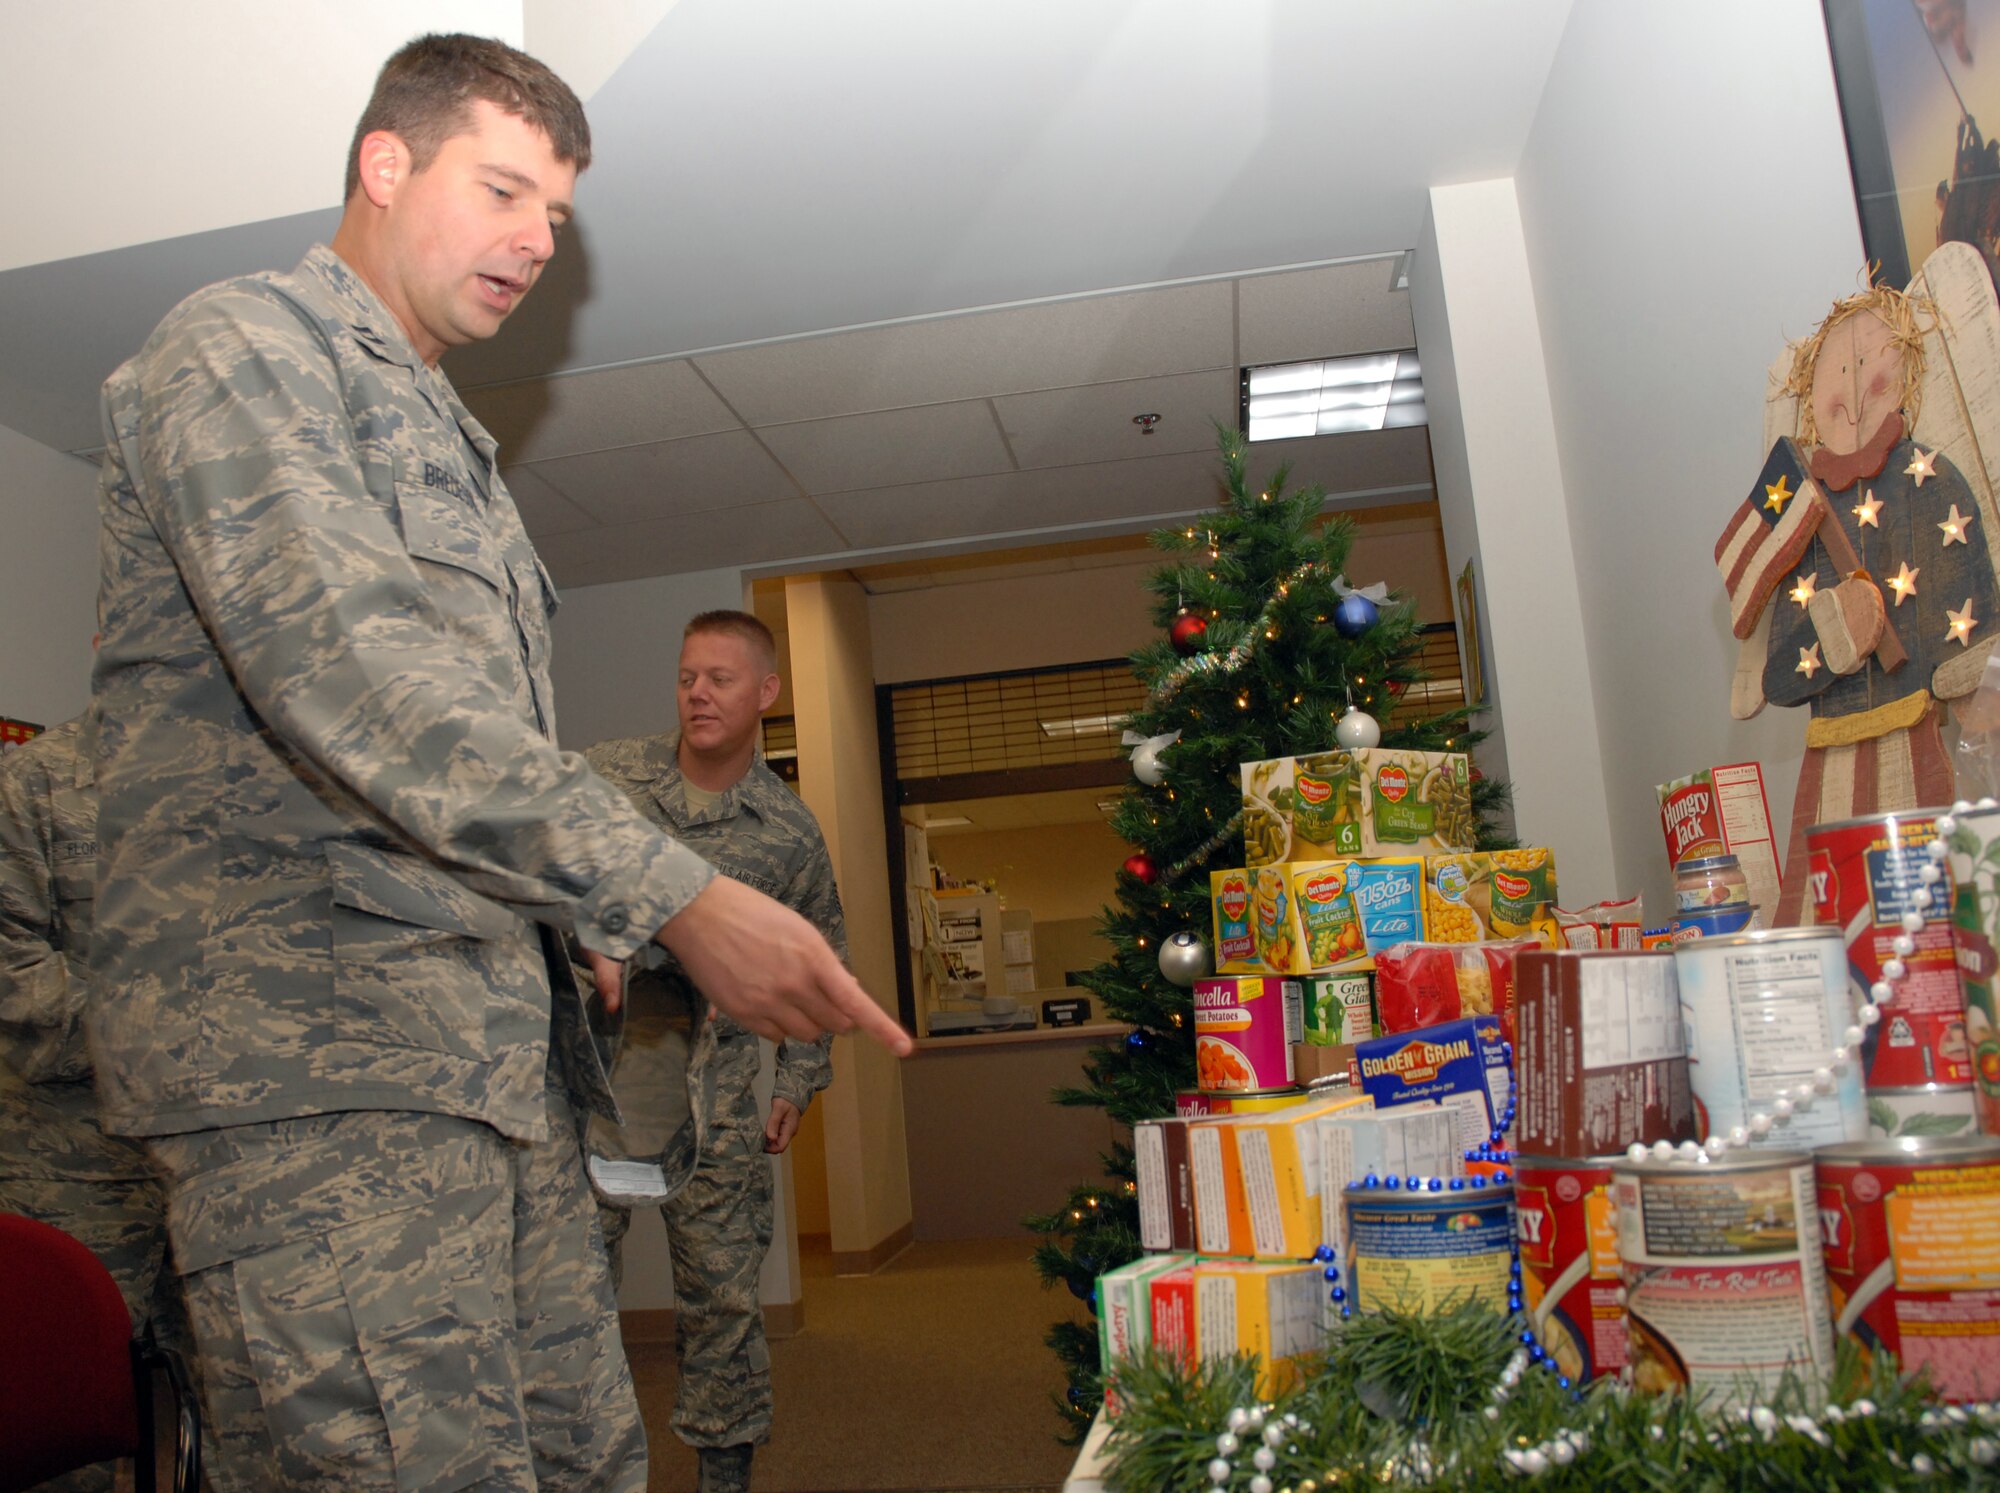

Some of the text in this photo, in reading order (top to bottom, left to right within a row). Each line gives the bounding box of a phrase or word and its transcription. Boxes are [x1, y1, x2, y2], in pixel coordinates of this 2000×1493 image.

[1457, 761, 1464, 776] 6
[1380, 776, 1406, 788] Del Monte
[1664, 792, 1709, 835] Hungry
[1341, 824, 1353, 844] 6
[1675, 817, 1705, 855] Jack
[1337, 845, 1359, 853] CANS
[719, 864, 777, 894] U.S. AIR FORCE
[1386, 870, 1394, 881] 6
[1307, 881, 1340, 896] Del Monte
[1497, 876, 1528, 891] Del Monte
[1375, 898, 1401, 911] cans
[1371, 919, 1409, 933] Lite
[1207, 1011, 1239, 1022] Potatoes
[1361, 1051, 1415, 1078] GOLDEN
[1423, 1039, 1471, 1065] GRAIN
[1404, 1066, 1434, 1080] MISSION
